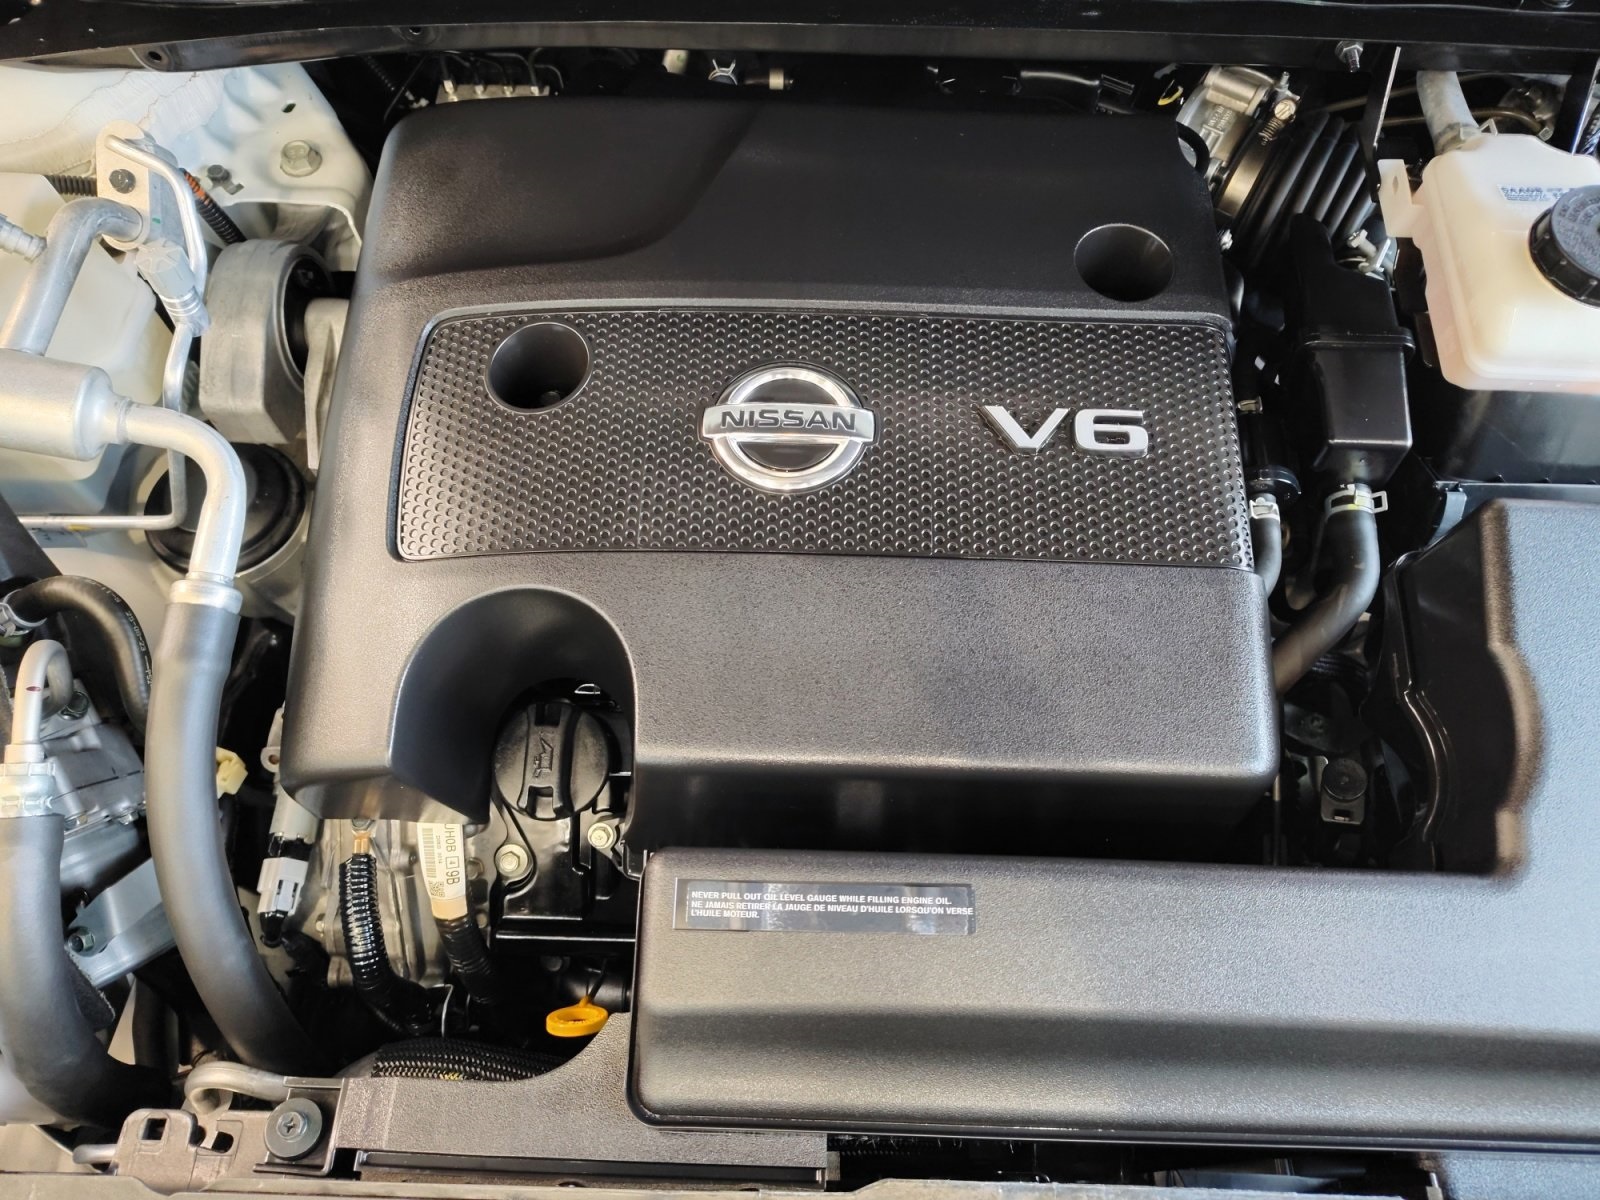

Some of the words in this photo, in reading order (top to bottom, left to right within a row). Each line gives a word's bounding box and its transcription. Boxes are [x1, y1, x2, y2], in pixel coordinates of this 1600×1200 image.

[721, 408, 856, 432] NISSAN
[980, 405, 1149, 458] V6
[445, 870, 460, 885] 9B
[691, 890, 720, 899] NEVER
[721, 891, 742, 900] PULL
[743, 892, 762, 901] OUT
[763, 893, 779, 901] OIL
[780, 893, 805, 902] LEVEL
[806, 894, 837, 903] GAUGE
[839, 895, 866, 903] WHILE
[867, 895, 900, 904] FILLING
[900, 896, 933, 905] ENGINE
[935, 897, 952, 905] OIL.
[690, 909, 721, 918] L'HUILE
[723, 909, 760, 919] MOTEUR.
[691, 900, 704, 909] NE
[704, 901, 735, 910] JAMAIS
[736, 902, 772, 910] RETIRER
[772, 903, 783, 911] LA
[784, 903, 812, 912] JAUGE
[813, 904, 825, 912] DE
[827, 904, 859, 913] NIVEAU
[860, 905, 894, 914] D'HUILE
[895, 906, 944, 915] LORSQU'ON
[945, 907, 974, 916] VERSE
